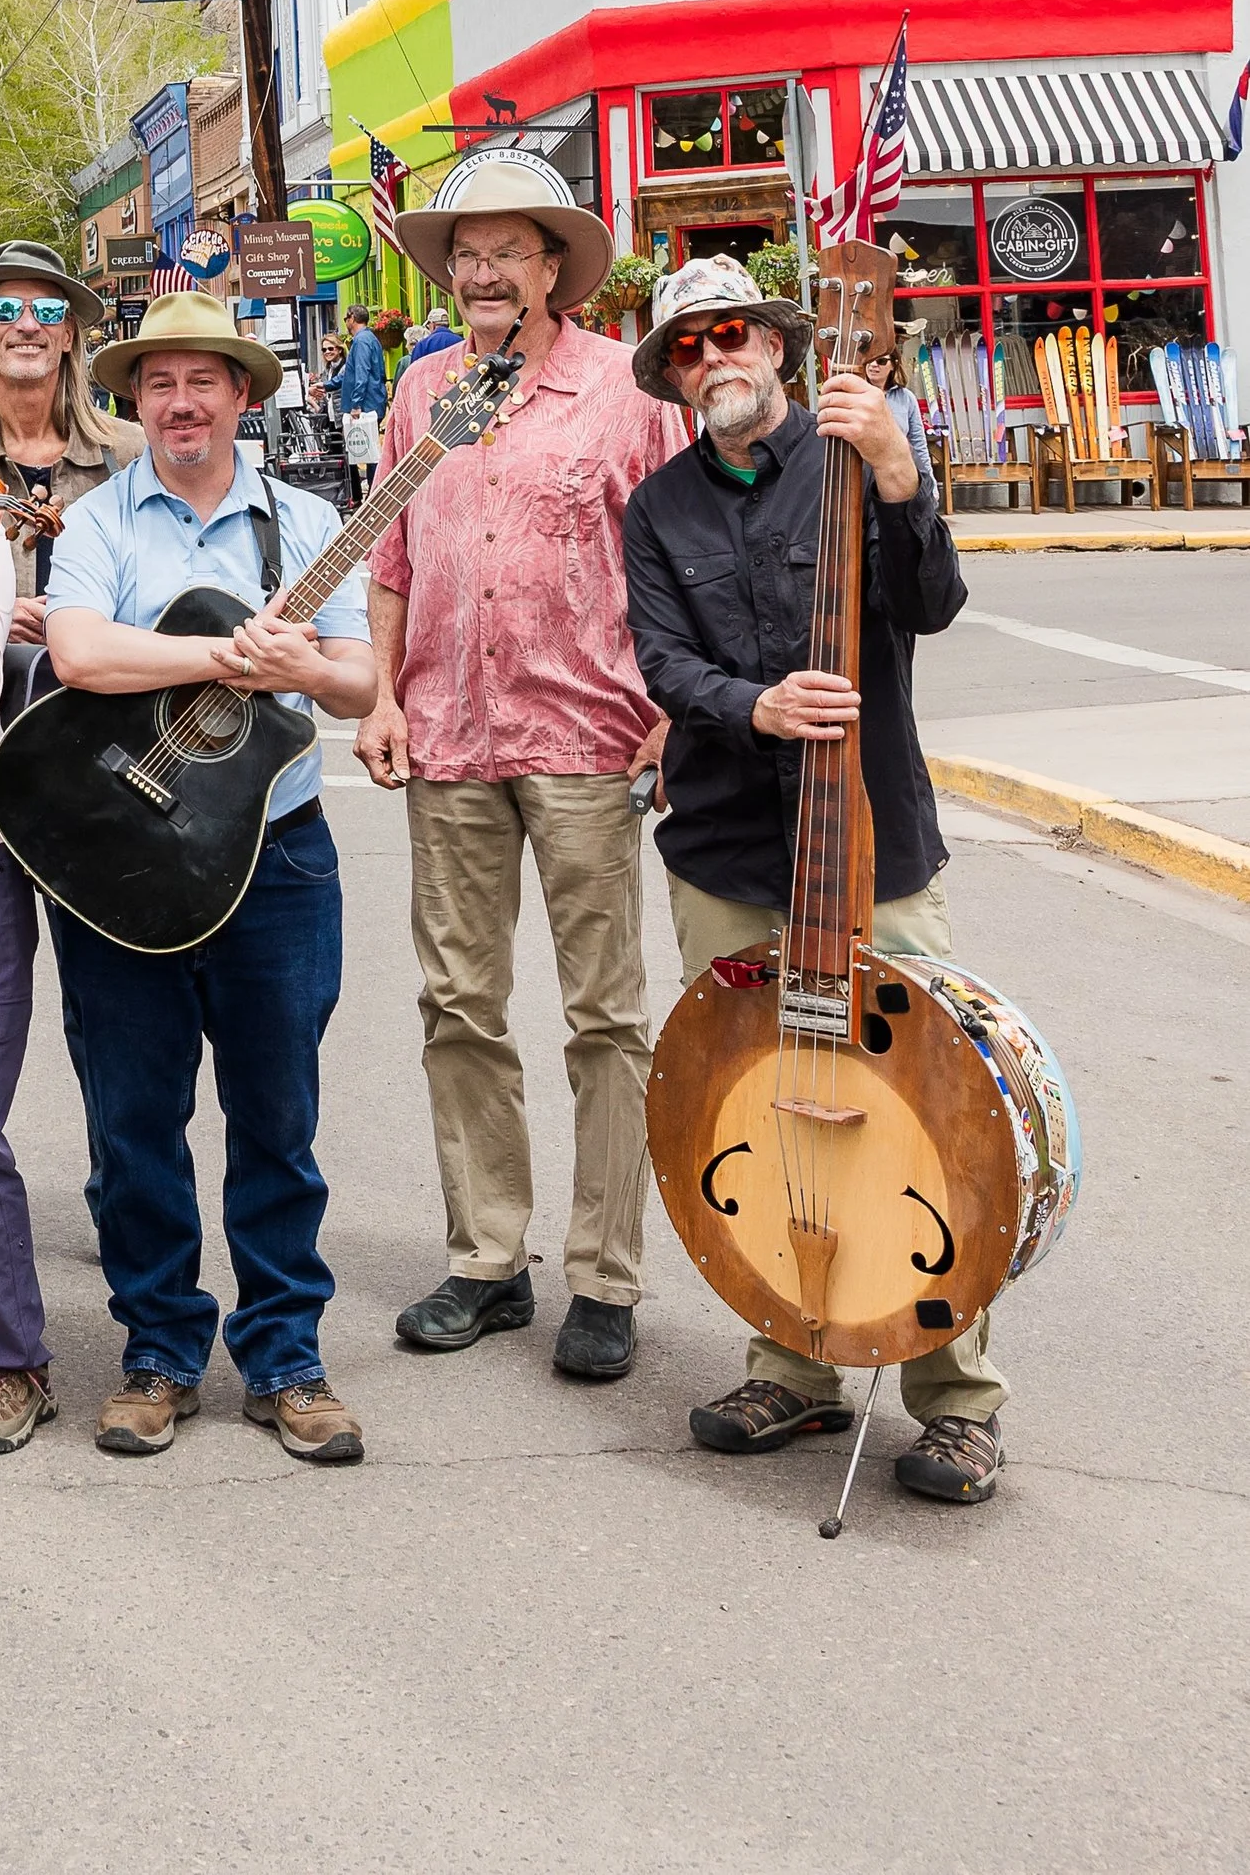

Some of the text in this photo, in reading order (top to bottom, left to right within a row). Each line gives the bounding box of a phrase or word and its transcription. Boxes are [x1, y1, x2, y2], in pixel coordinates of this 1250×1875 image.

[465, 151, 495, 169] ELEV.
[531, 158, 545, 169] FT
[306, 218, 349, 230] reede
[243, 232, 310, 245] Mining Museum
[313, 233, 363, 248] ve Oil
[111, 256, 145, 267] CREEDE
[246, 253, 290, 263] Gift Shop
[1034, 255, 1064, 272] COLORADO
[246, 267, 295, 278] Community
[260, 276, 287, 286] Center
[103, 297, 118, 305] USE
